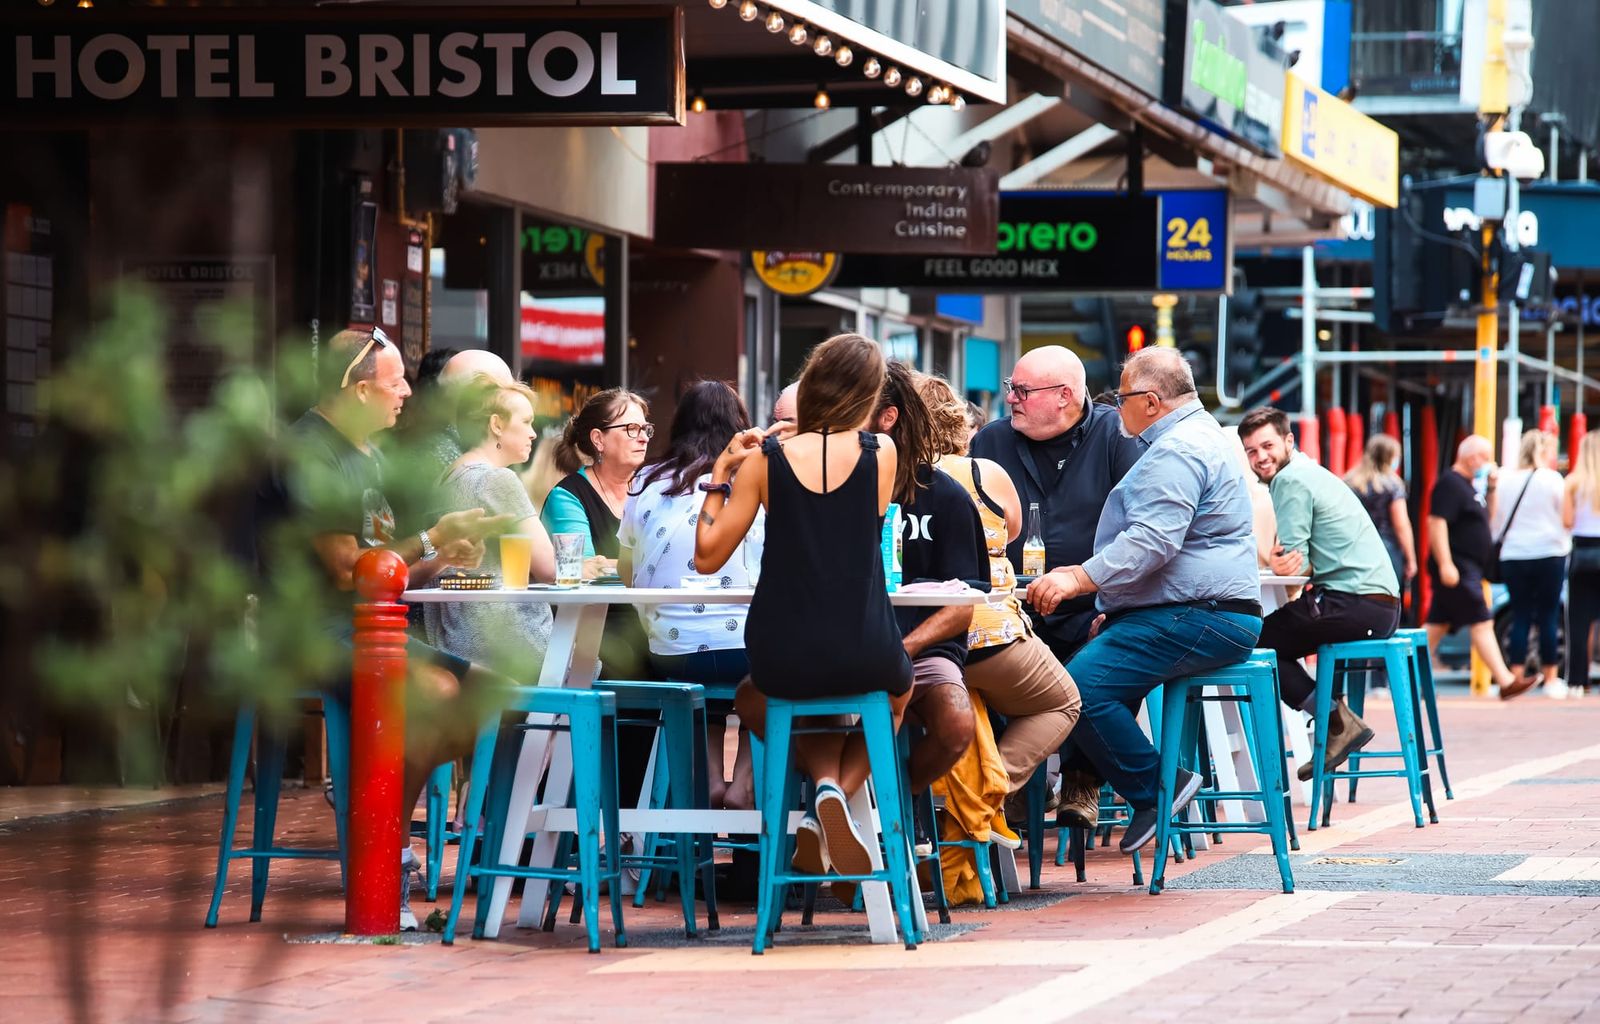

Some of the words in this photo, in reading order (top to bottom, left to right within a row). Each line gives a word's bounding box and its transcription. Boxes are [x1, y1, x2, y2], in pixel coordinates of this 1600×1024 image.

[16, 33, 274, 99] HOTEL
[305, 31, 636, 98] BRISTOL
[828, 180, 967, 199] Contemporary
[906, 202, 967, 217] Indian
[895, 220, 967, 239] Cuisine
[1167, 217, 1213, 247] 24
[924, 258, 967, 277] FEEL
[970, 258, 1018, 277] GOOD
[1021, 258, 1059, 277] MEX
